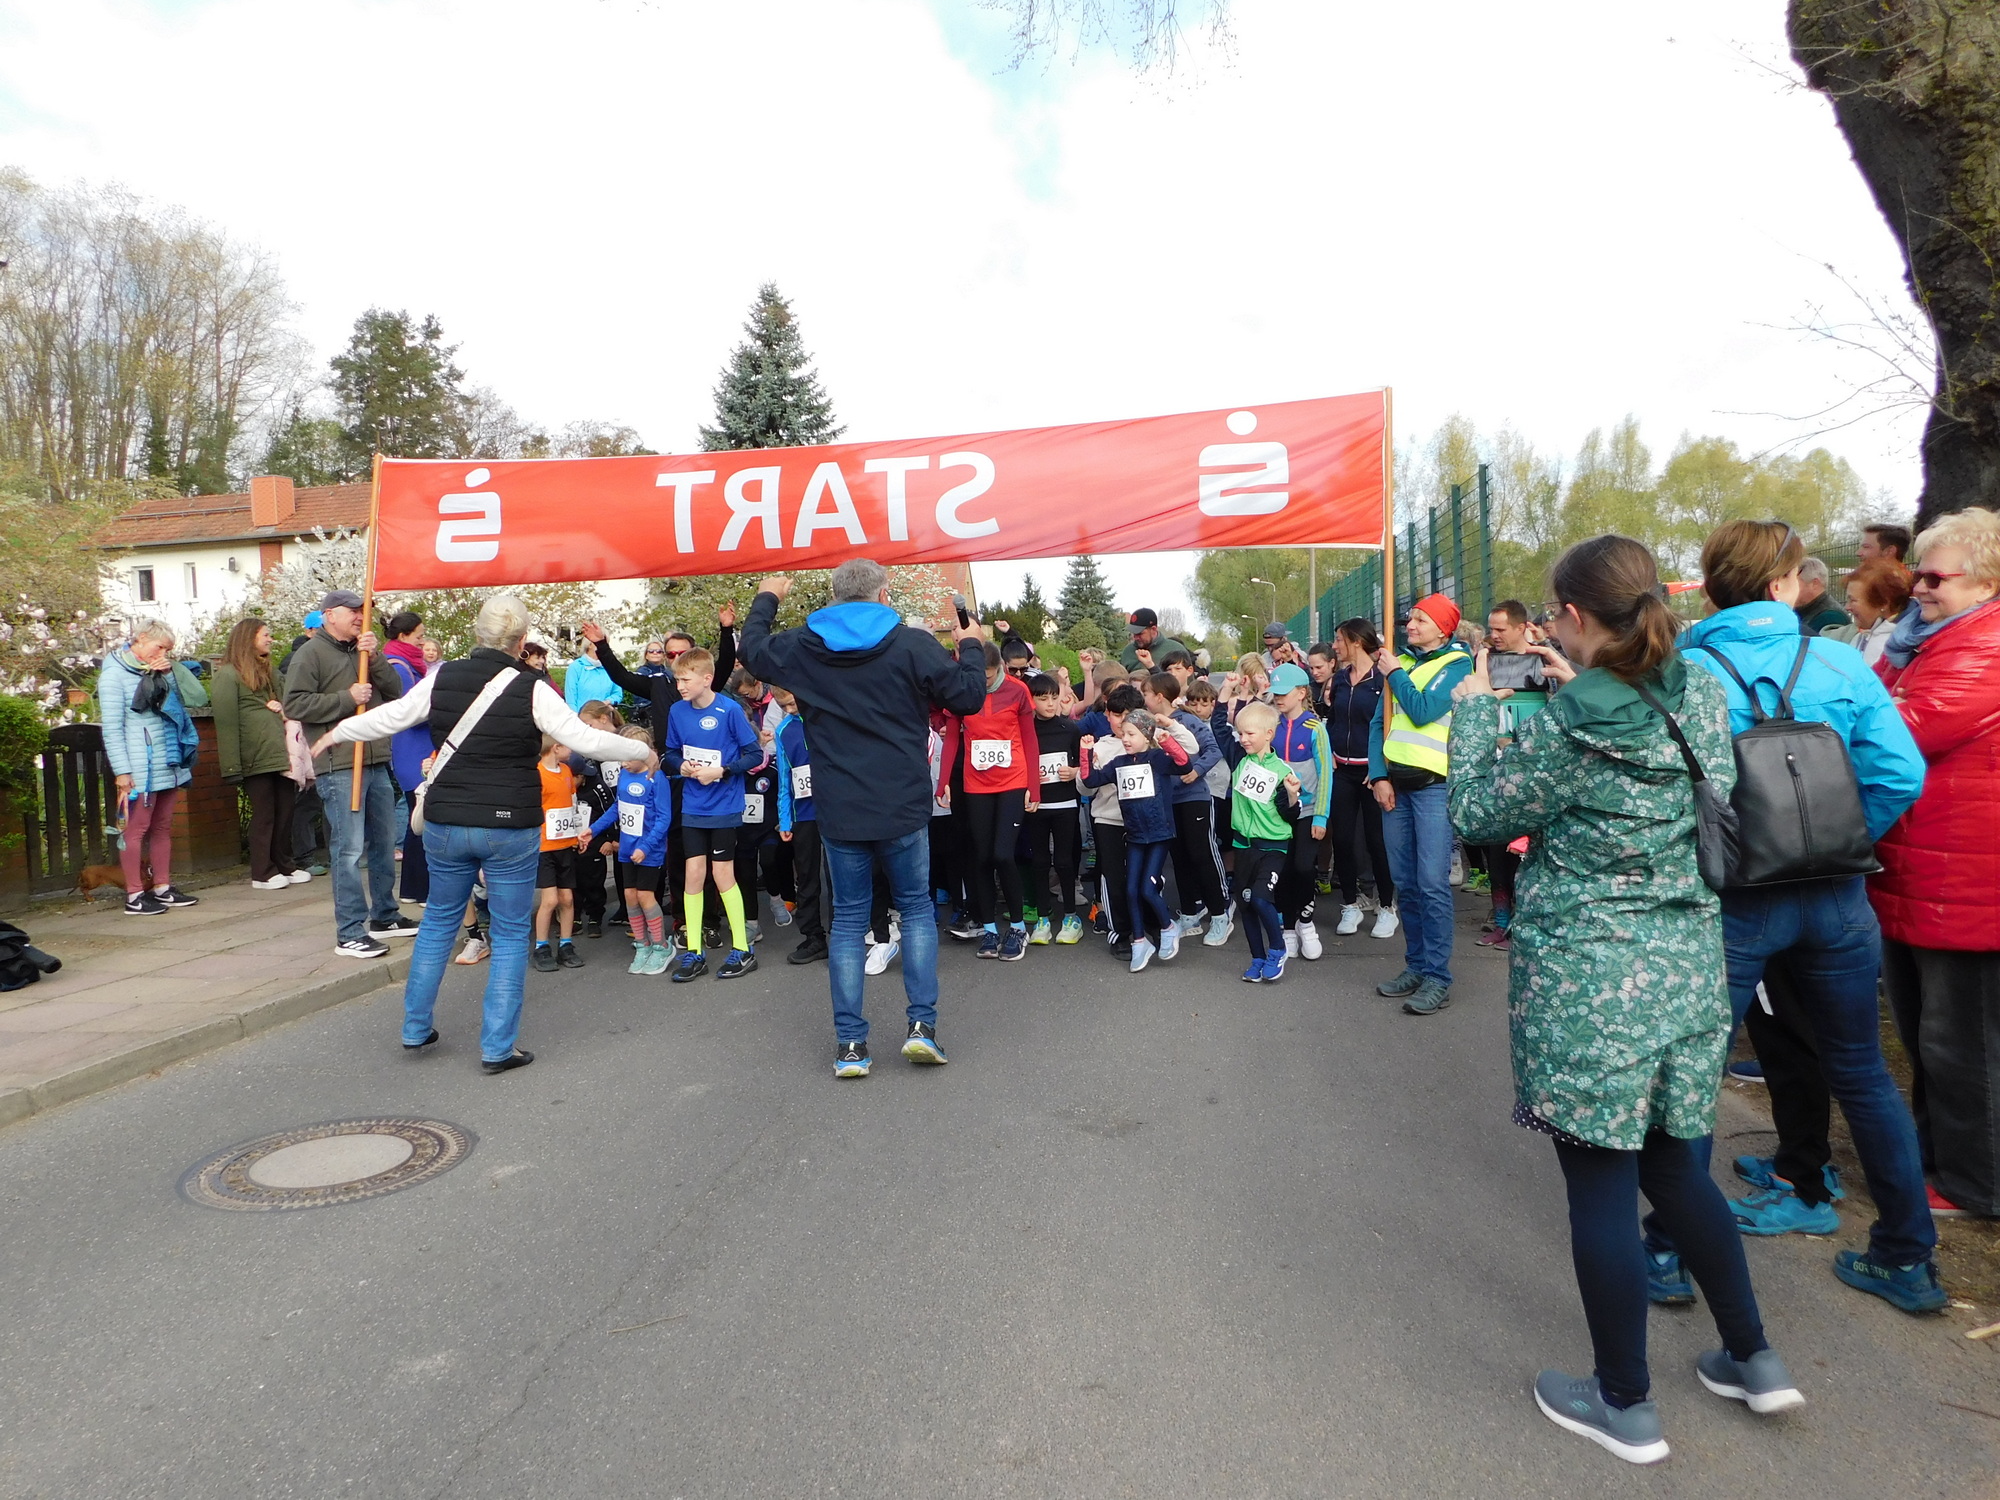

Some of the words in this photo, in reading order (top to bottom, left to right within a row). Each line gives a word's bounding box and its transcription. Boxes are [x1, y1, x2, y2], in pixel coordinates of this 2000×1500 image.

[979, 751, 1005, 763] 386
[1122, 776, 1144, 791] 497
[1243, 774, 1266, 794] 496
[742, 804, 756, 816] 2
[555, 818, 575, 831] 394
[620, 813, 634, 827] 58
